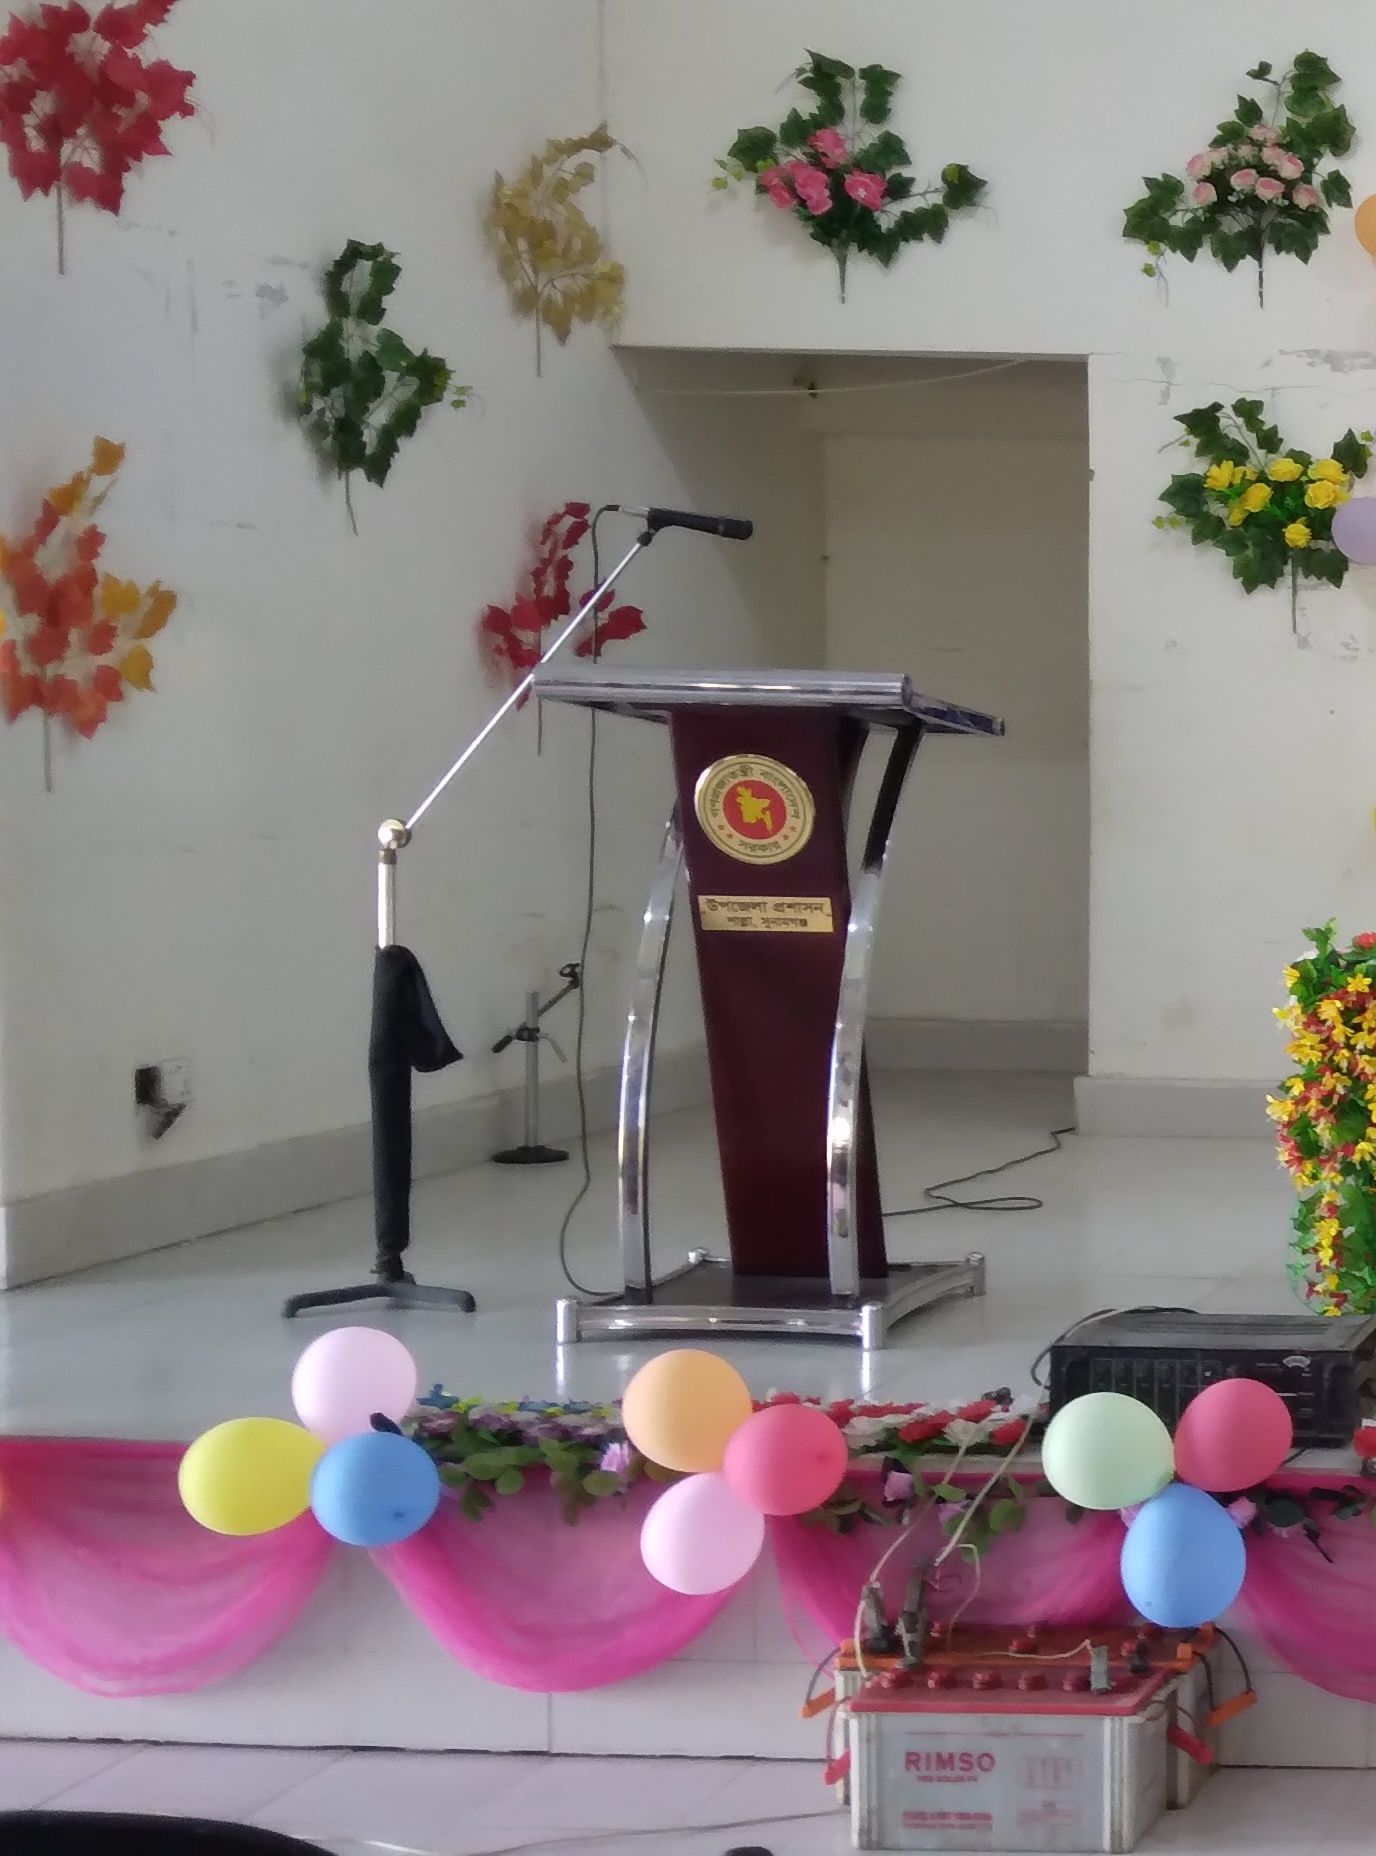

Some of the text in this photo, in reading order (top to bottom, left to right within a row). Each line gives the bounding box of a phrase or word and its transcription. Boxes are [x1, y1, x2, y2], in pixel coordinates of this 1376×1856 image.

[706, 898, 825, 913] উপজেলা প্রশাসন
[905, 1752, 996, 1773] RIMSO
